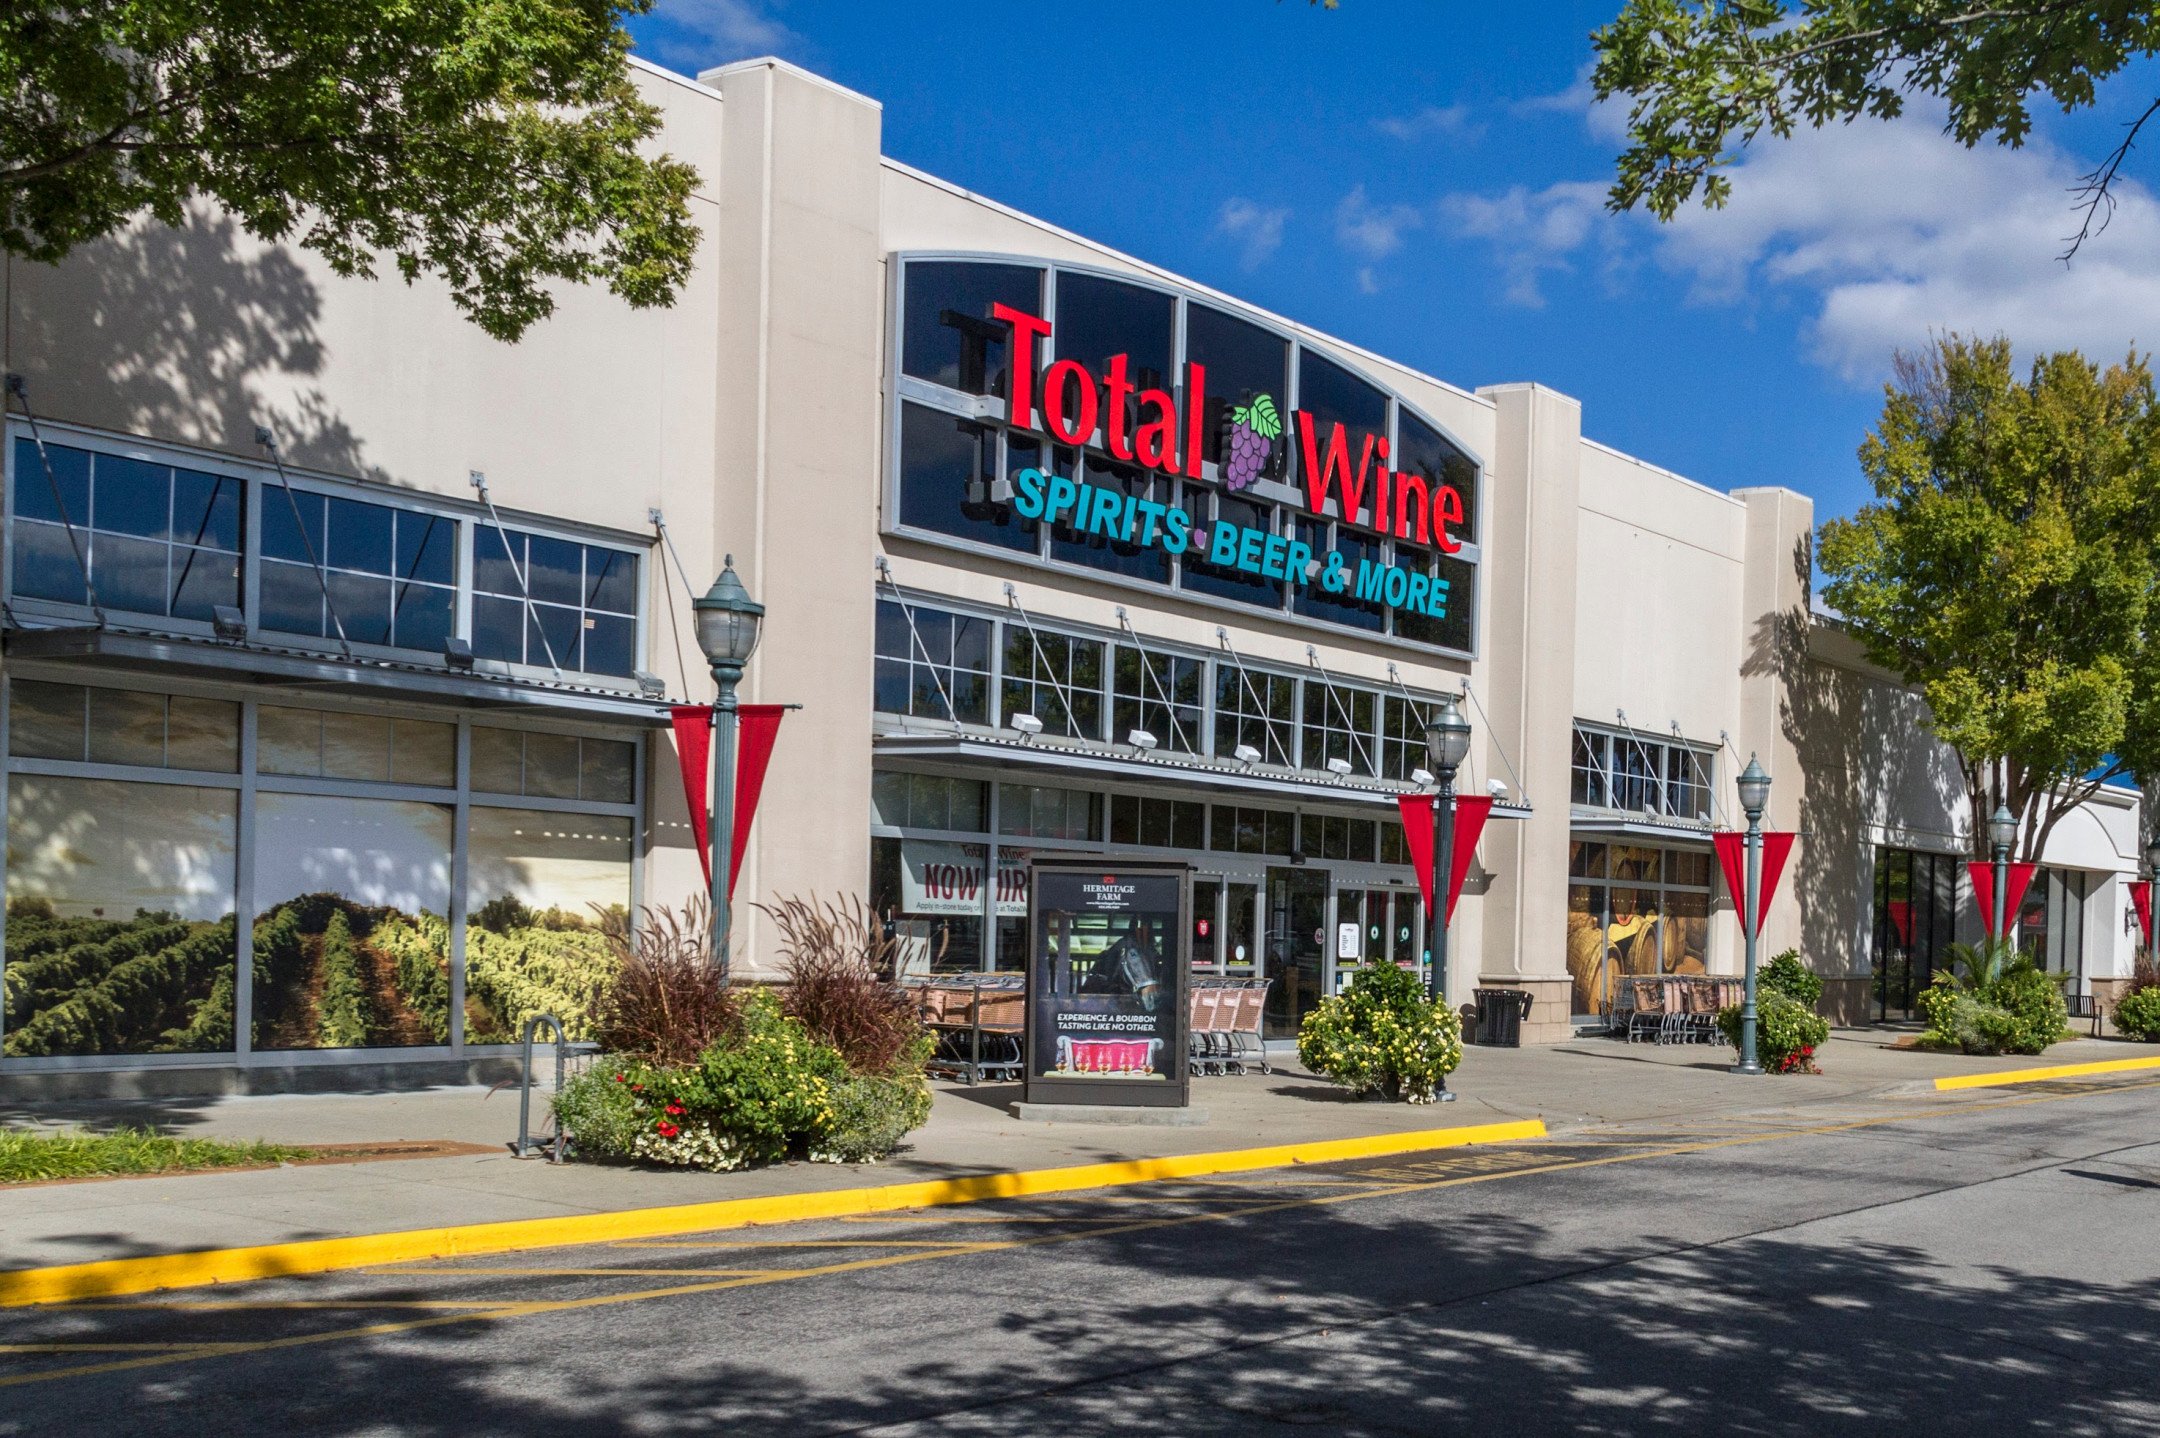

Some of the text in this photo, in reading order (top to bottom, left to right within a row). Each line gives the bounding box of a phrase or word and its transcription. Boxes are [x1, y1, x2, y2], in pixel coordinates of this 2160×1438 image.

[988, 301, 1464, 554] Total Wine
[1012, 468, 1450, 619] SPIRITS BEER & MORE
[960, 844, 984, 859] Tota
[924, 863, 980, 901] NOW
[1083, 884, 1136, 893] HERMITAGE
[1096, 892, 1122, 901] FARM
[916, 901, 933, 912] Apply
[1057, 1013, 1157, 1023] EXPERIENCE A BOURBON
[1057, 1022, 1156, 1032] TASTING LIKE NO OTHER.
